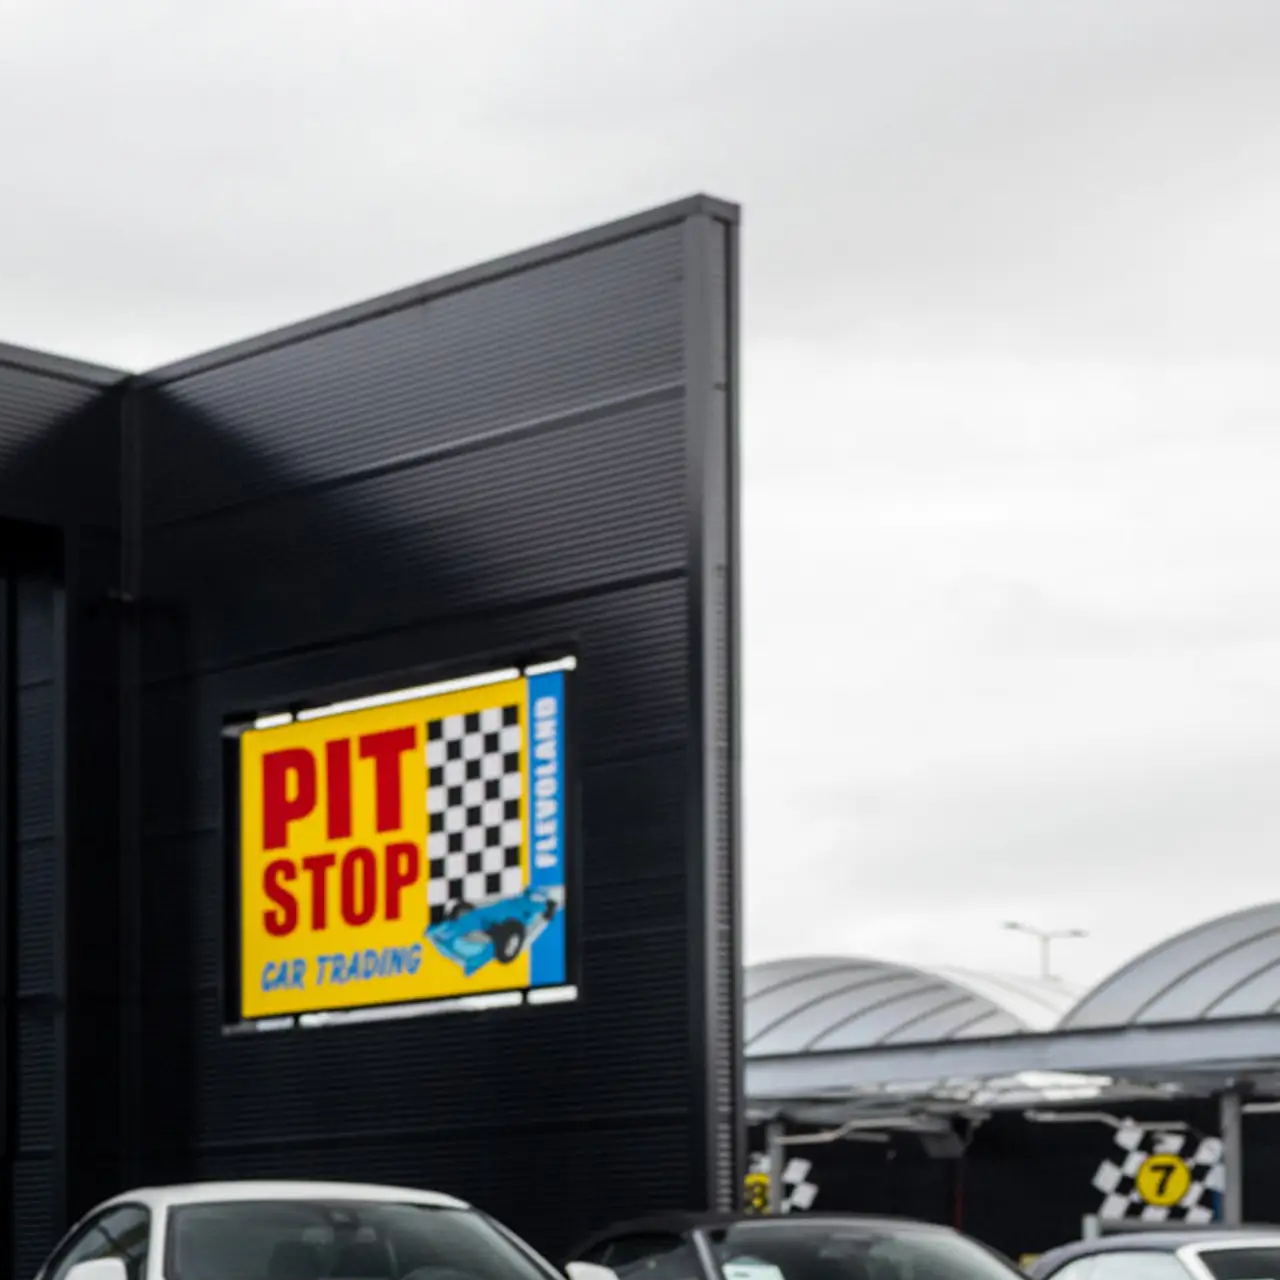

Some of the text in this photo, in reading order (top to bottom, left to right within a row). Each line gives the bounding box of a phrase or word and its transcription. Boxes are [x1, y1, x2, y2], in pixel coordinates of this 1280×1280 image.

[262, 724, 418, 850] PIT
[262, 841, 421, 937] STOP
[260, 943, 423, 992] CAR TRADING
[1150, 1164, 1176, 1196] 7
